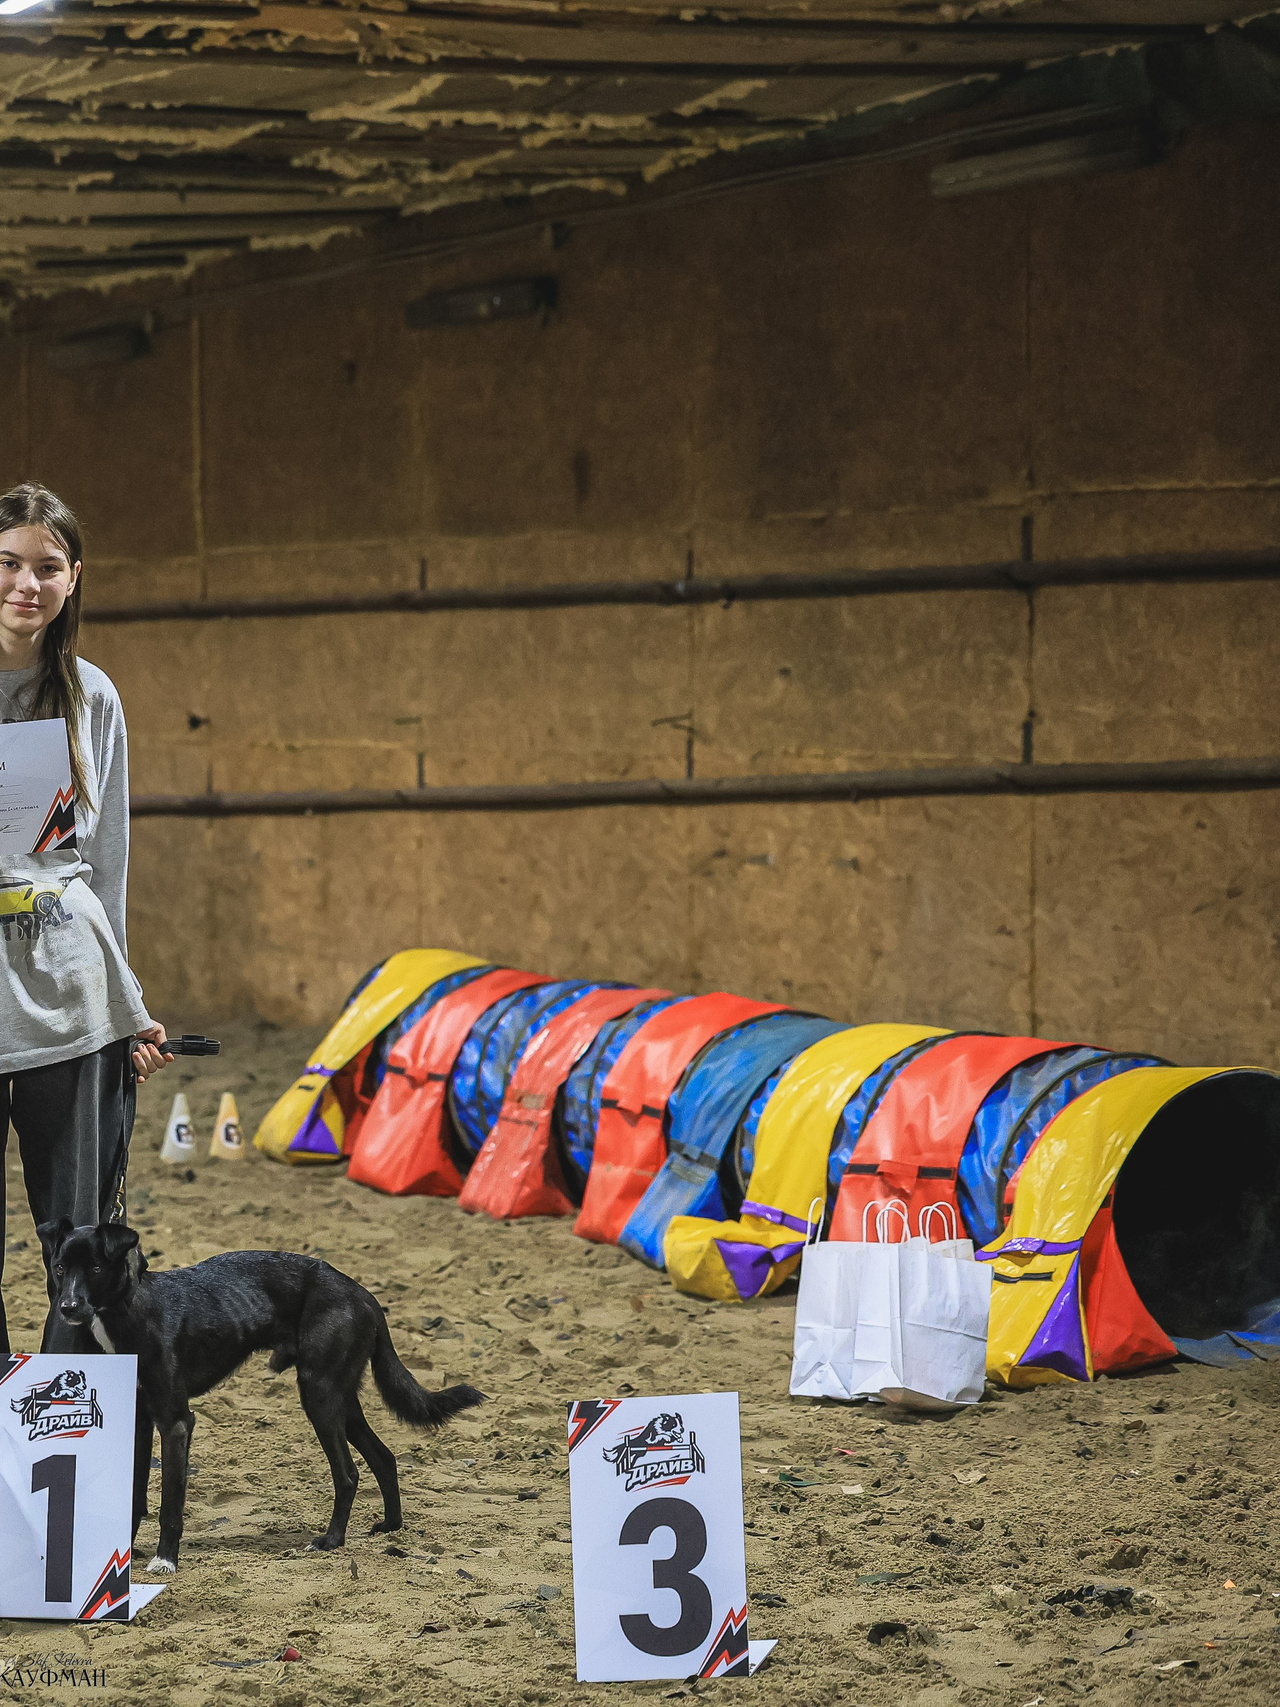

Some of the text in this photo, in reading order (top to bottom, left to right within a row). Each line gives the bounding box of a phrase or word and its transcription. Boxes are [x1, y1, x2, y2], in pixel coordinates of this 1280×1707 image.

[28, 1410, 94, 1441] ДРАЙВ
[625, 1455, 695, 1491] ДРАЙВ
[31, 1454, 77, 1602] 1
[619, 1497, 712, 1656] 3
